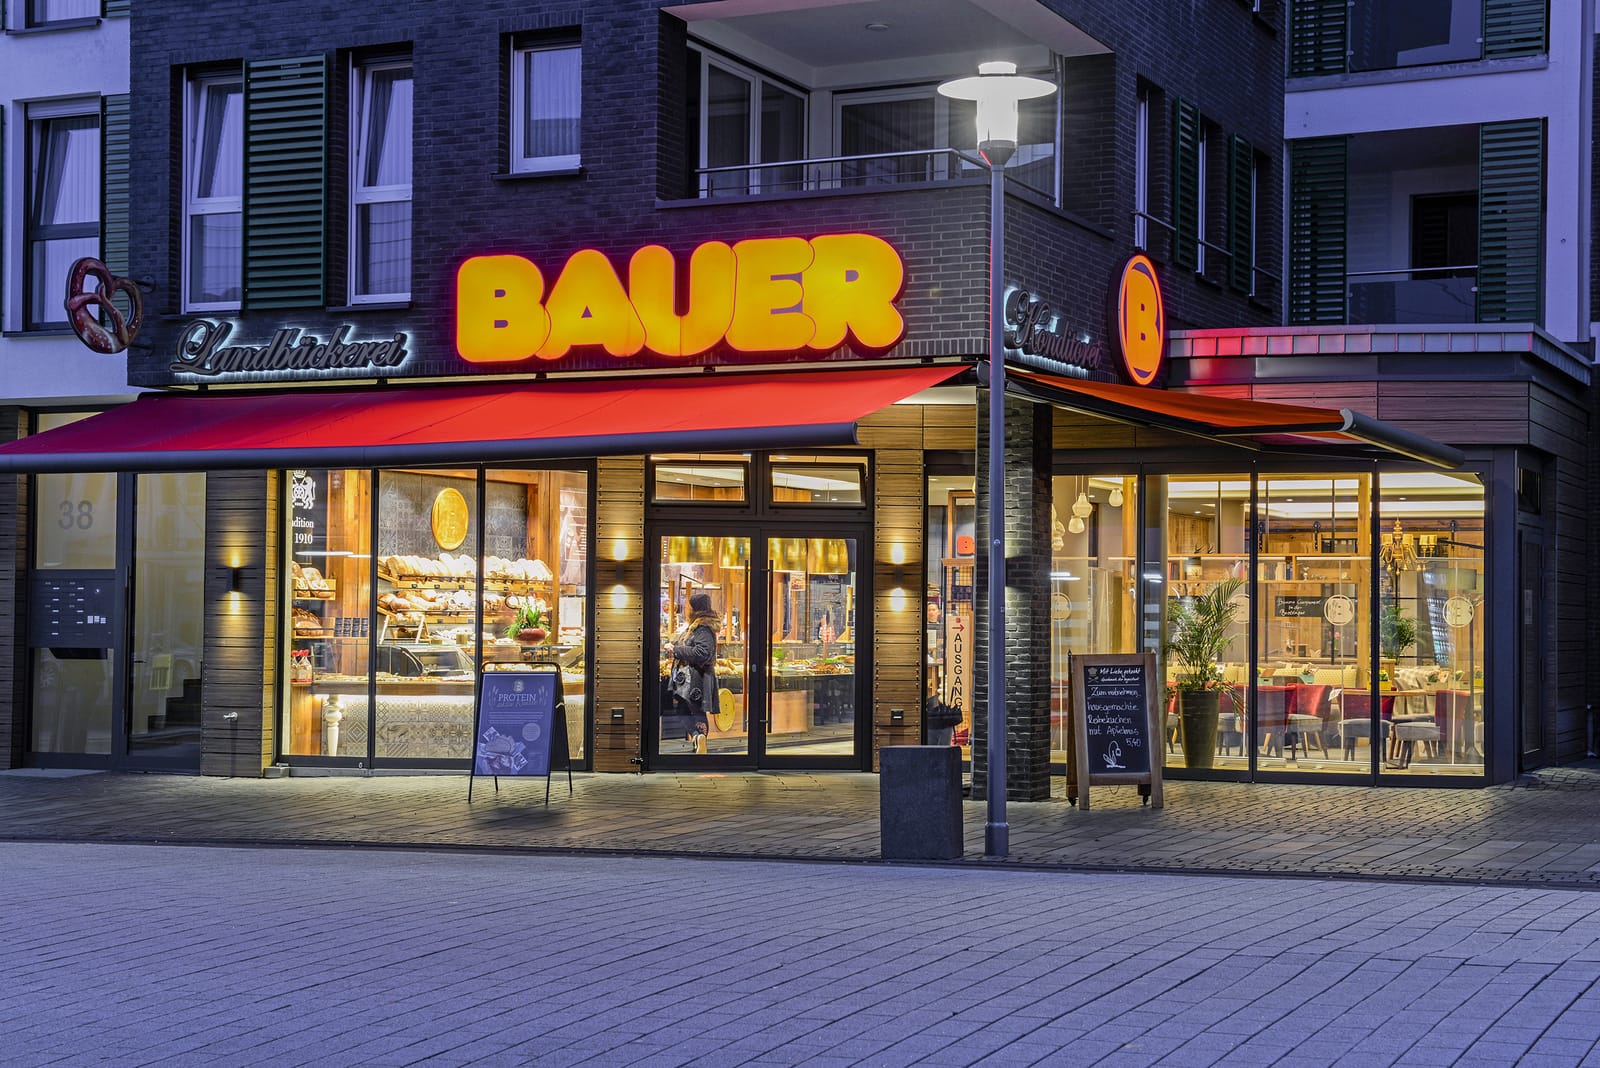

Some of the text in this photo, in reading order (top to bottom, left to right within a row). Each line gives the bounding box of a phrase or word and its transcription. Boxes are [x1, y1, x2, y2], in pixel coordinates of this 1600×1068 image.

[456, 233, 904, 363] BAUER
[1122, 261, 1162, 380] B
[169, 318, 408, 376] Landbäckerei
[1003, 289, 1102, 370] Konditorei
[57, 500, 95, 531] 38
[291, 516, 315, 529] dition
[294, 532, 314, 545] 1910
[498, 693, 537, 702] PROTEIN
[953, 632, 963, 708] AUSGANG
